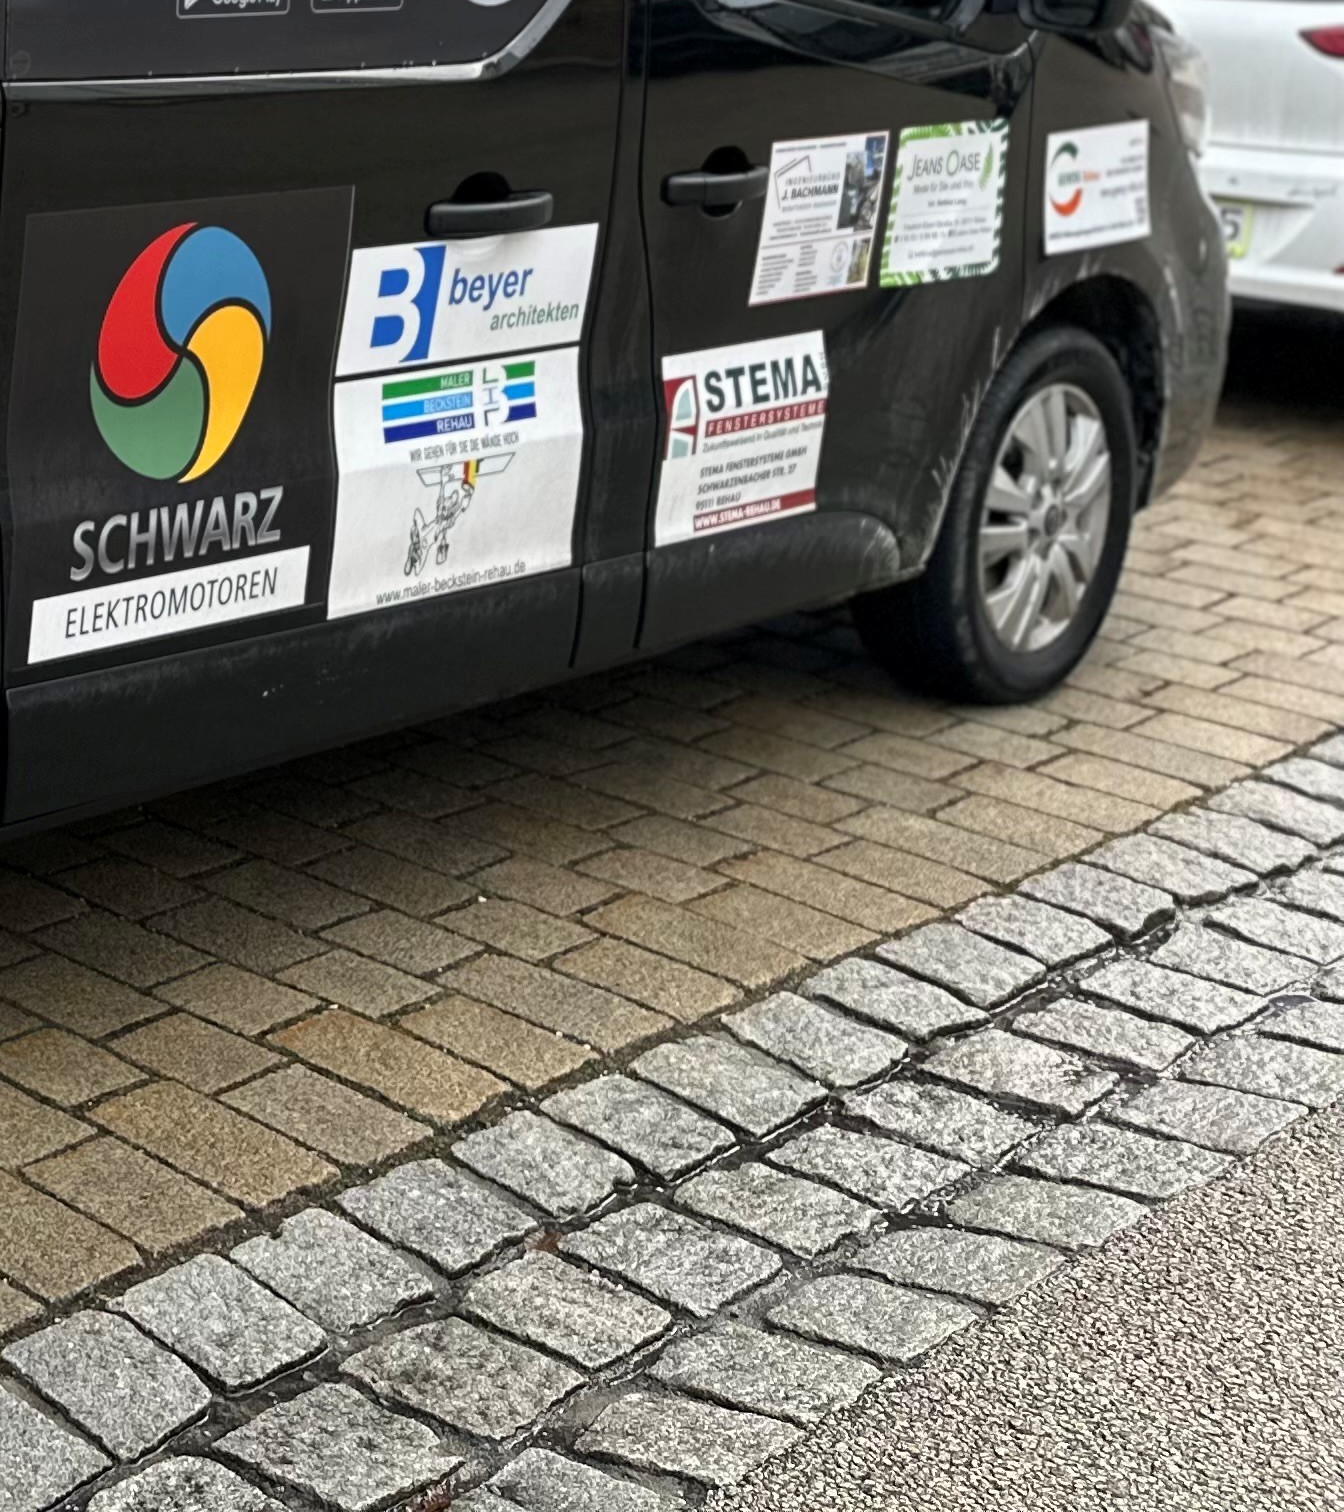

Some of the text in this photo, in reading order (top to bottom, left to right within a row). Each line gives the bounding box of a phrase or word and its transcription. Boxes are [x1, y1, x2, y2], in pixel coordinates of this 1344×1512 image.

[907, 149, 980, 181] JEANS OASE
[791, 184, 839, 199] BACHMANN
[448, 264, 533, 309] beyer
[489, 300, 579, 332] architekten
[440, 372, 471, 389] MALER
[704, 354, 822, 413] STEMA
[423, 393, 472, 414] BECKSTEIN
[707, 400, 825, 436] FENSTERSYSTEME
[436, 415, 473, 434] REHAU
[69, 486, 283, 581] SCHWARZ
[376, 559, 526, 605] www.maler-beckstein-rehau.de
[65, 566, 278, 639] ELEKTROMOTOREN
